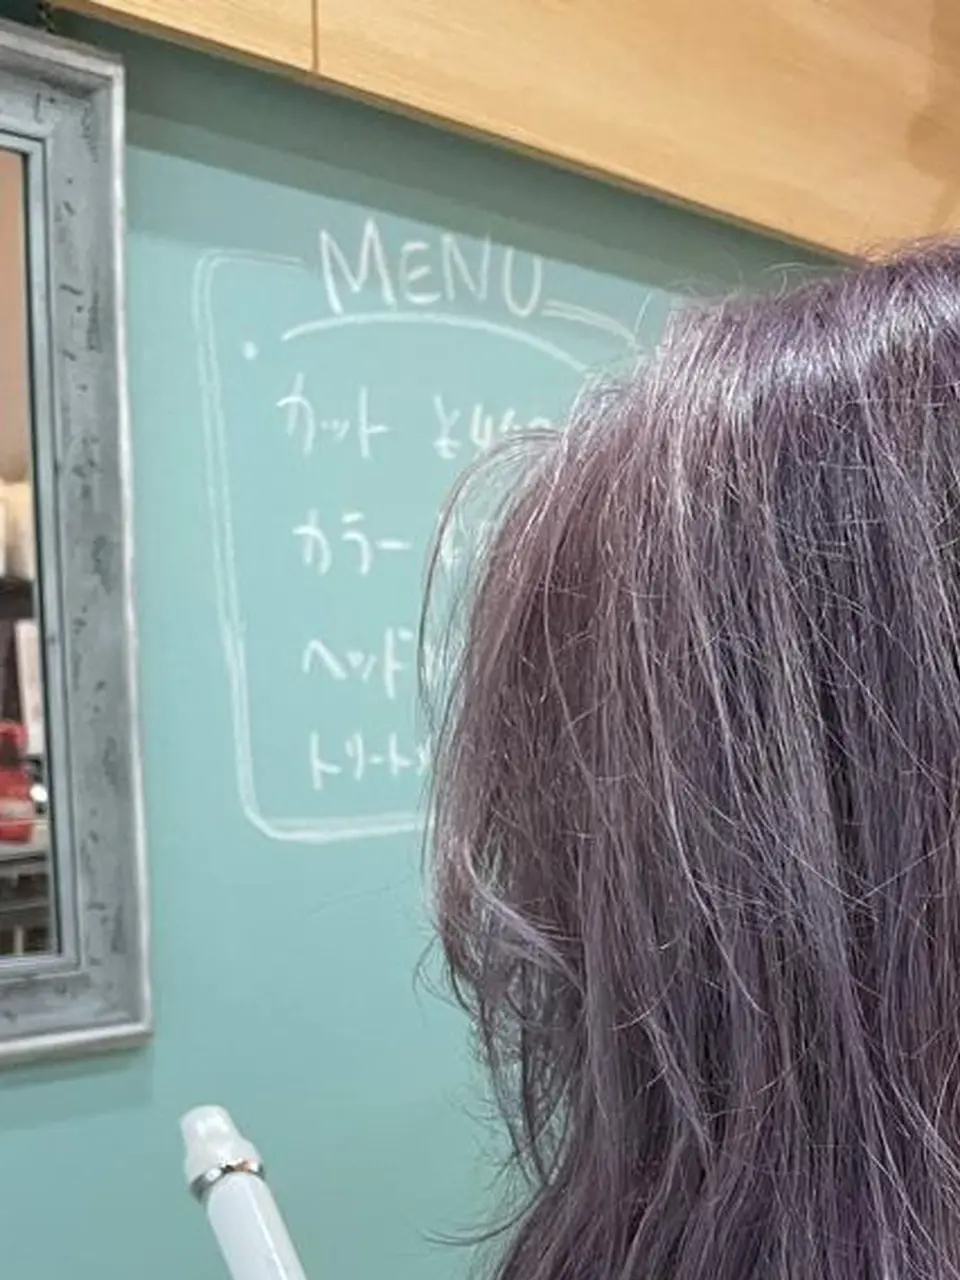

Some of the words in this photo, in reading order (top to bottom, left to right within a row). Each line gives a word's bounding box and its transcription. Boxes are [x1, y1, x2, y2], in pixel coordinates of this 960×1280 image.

[320, 217, 544, 317] MENU
[277, 372, 391, 459] カット
[293, 509, 411, 574] カラー
